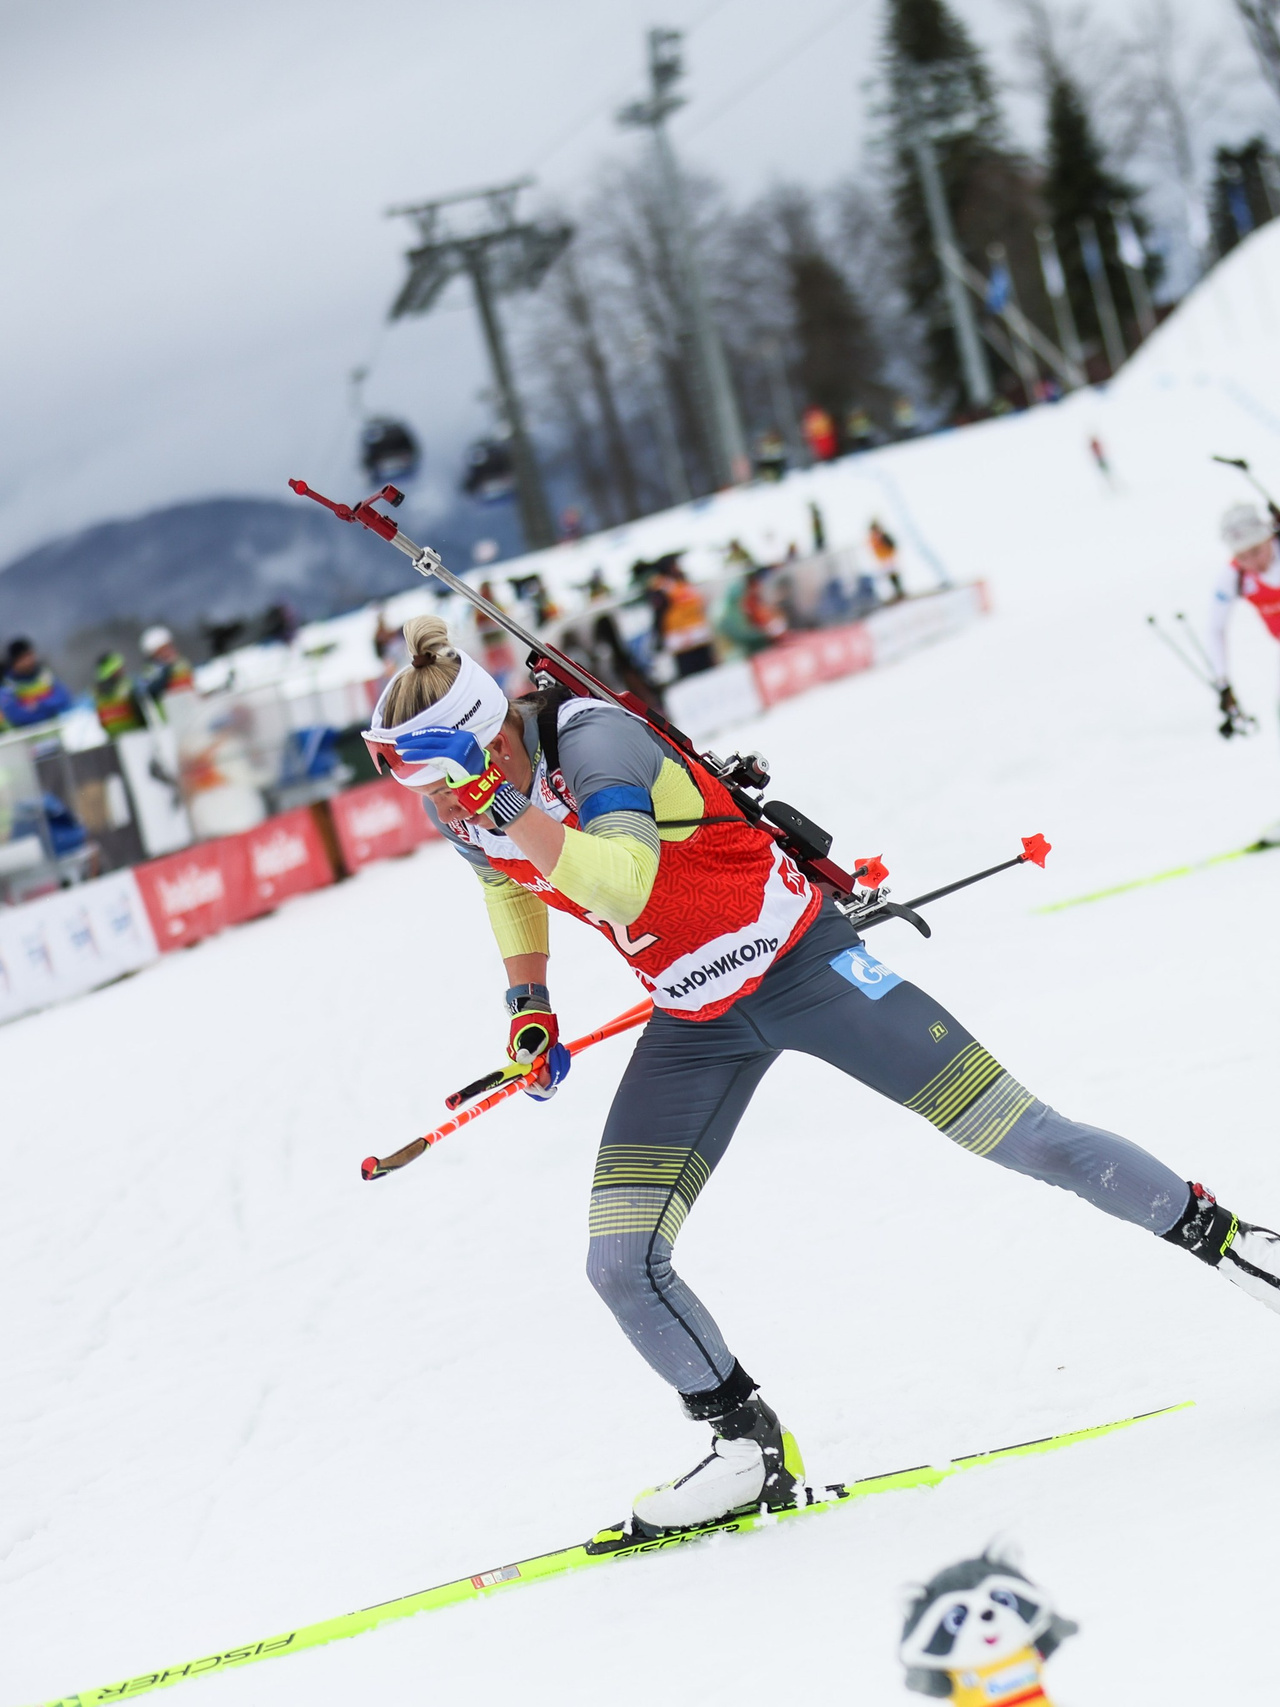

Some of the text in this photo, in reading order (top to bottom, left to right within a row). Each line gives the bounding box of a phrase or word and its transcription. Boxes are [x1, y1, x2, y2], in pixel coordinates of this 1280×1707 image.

[469, 768, 502, 801] LEKI
[664, 936, 779, 999] ХНОНИКОЛЬ
[97, 1632, 296, 1699] FISCHER
